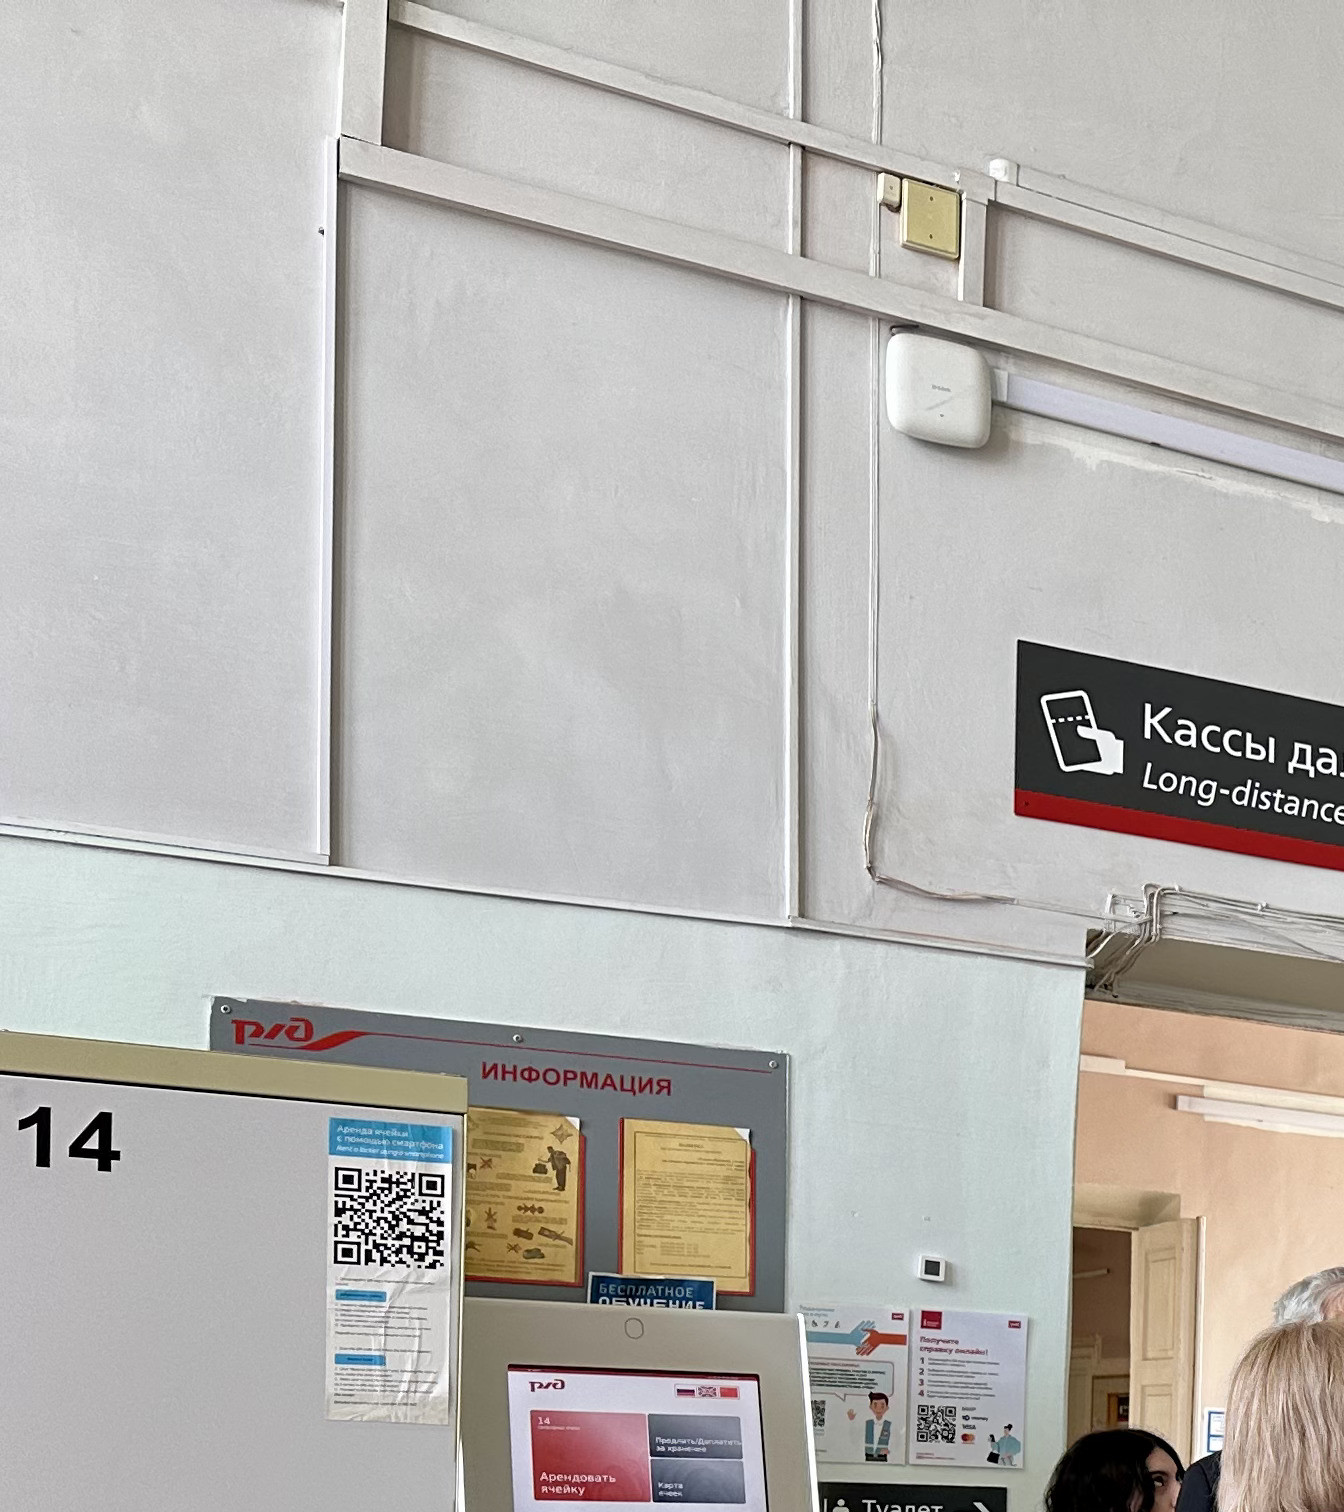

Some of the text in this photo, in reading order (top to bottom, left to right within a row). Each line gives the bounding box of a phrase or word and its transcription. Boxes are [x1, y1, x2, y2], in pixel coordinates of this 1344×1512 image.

[1143, 702, 1276, 764] Кассы
[481, 1061, 673, 1096] ИНФОРМАЦИЯ
[337, 1125, 373, 1135] Аренда
[18, 1106, 121, 1172] 14
[392, 1140, 444, 1150] смартфона
[599, 1283, 694, 1298] БЕСПЛАТНОЕ
[538, 1416, 551, 1425] 14
[540, 1471, 617, 1483] Арендовать
[541, 1484, 586, 1496] ячейку
